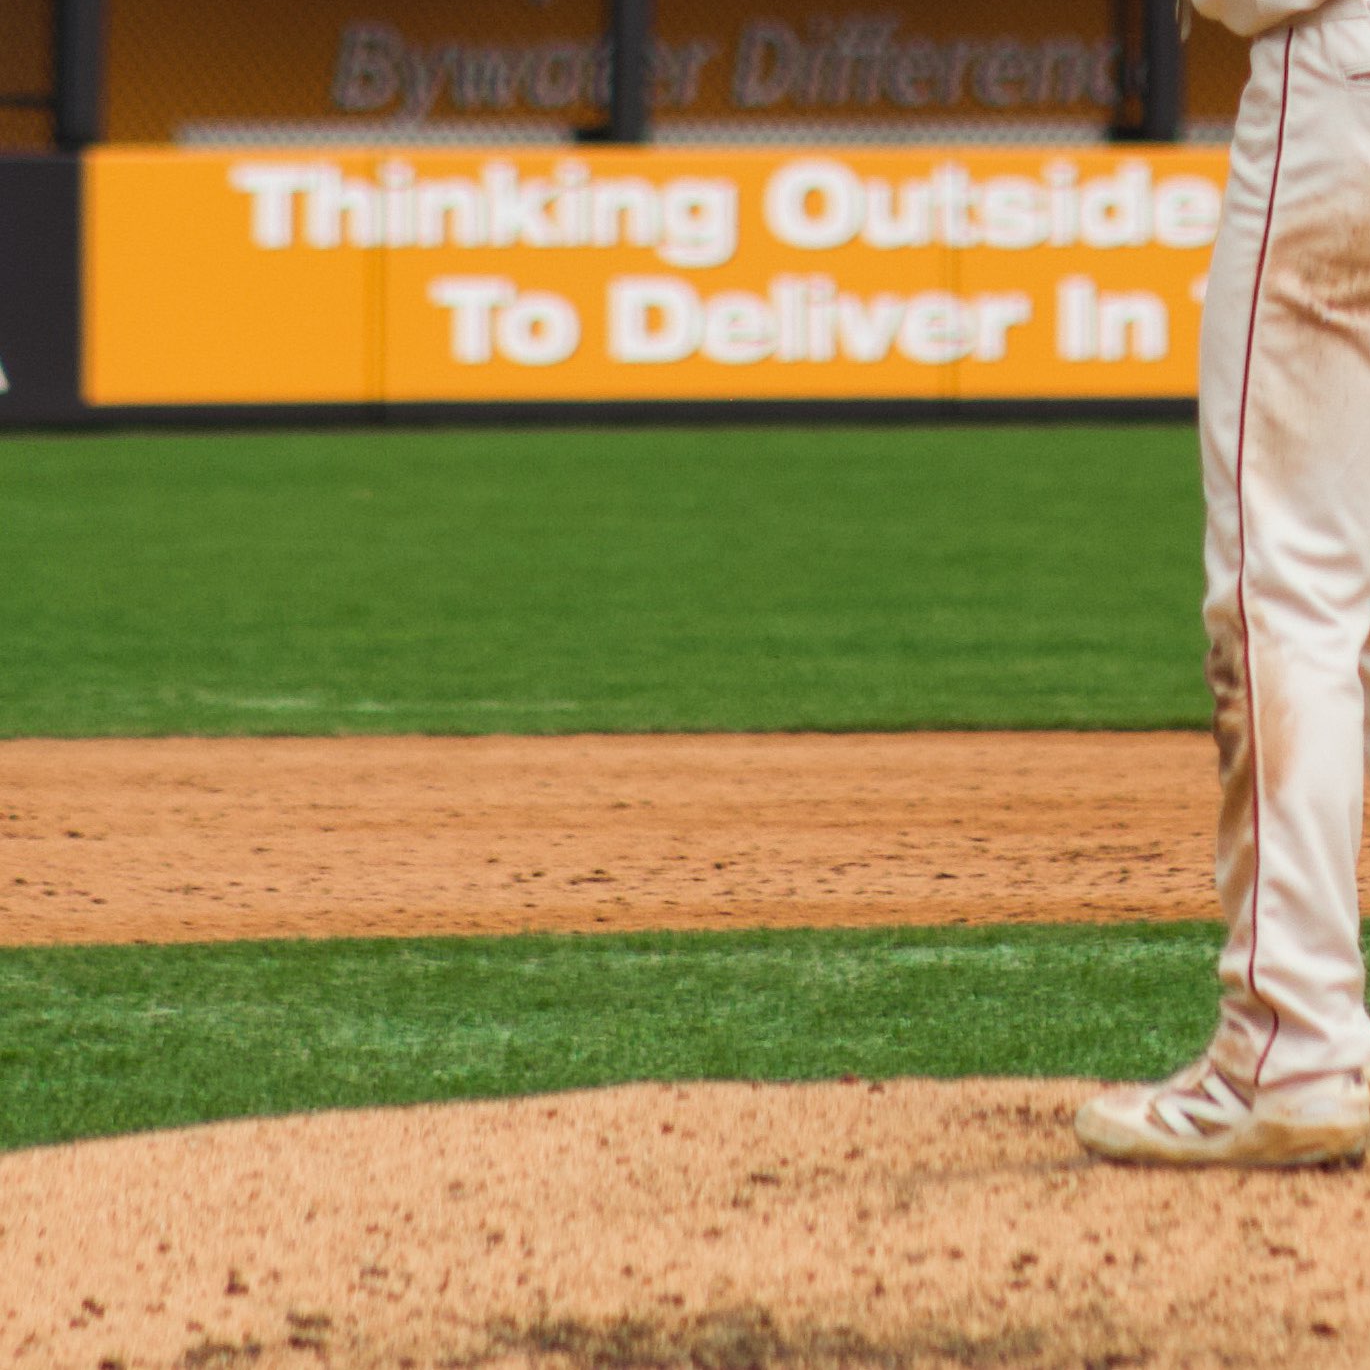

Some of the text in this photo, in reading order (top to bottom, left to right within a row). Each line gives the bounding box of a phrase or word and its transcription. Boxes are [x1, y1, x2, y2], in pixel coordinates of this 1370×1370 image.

[230, 162, 738, 268] Thinking
[764, 162, 1222, 250] Outside
[428, 278, 1168, 366] To Deliver In
